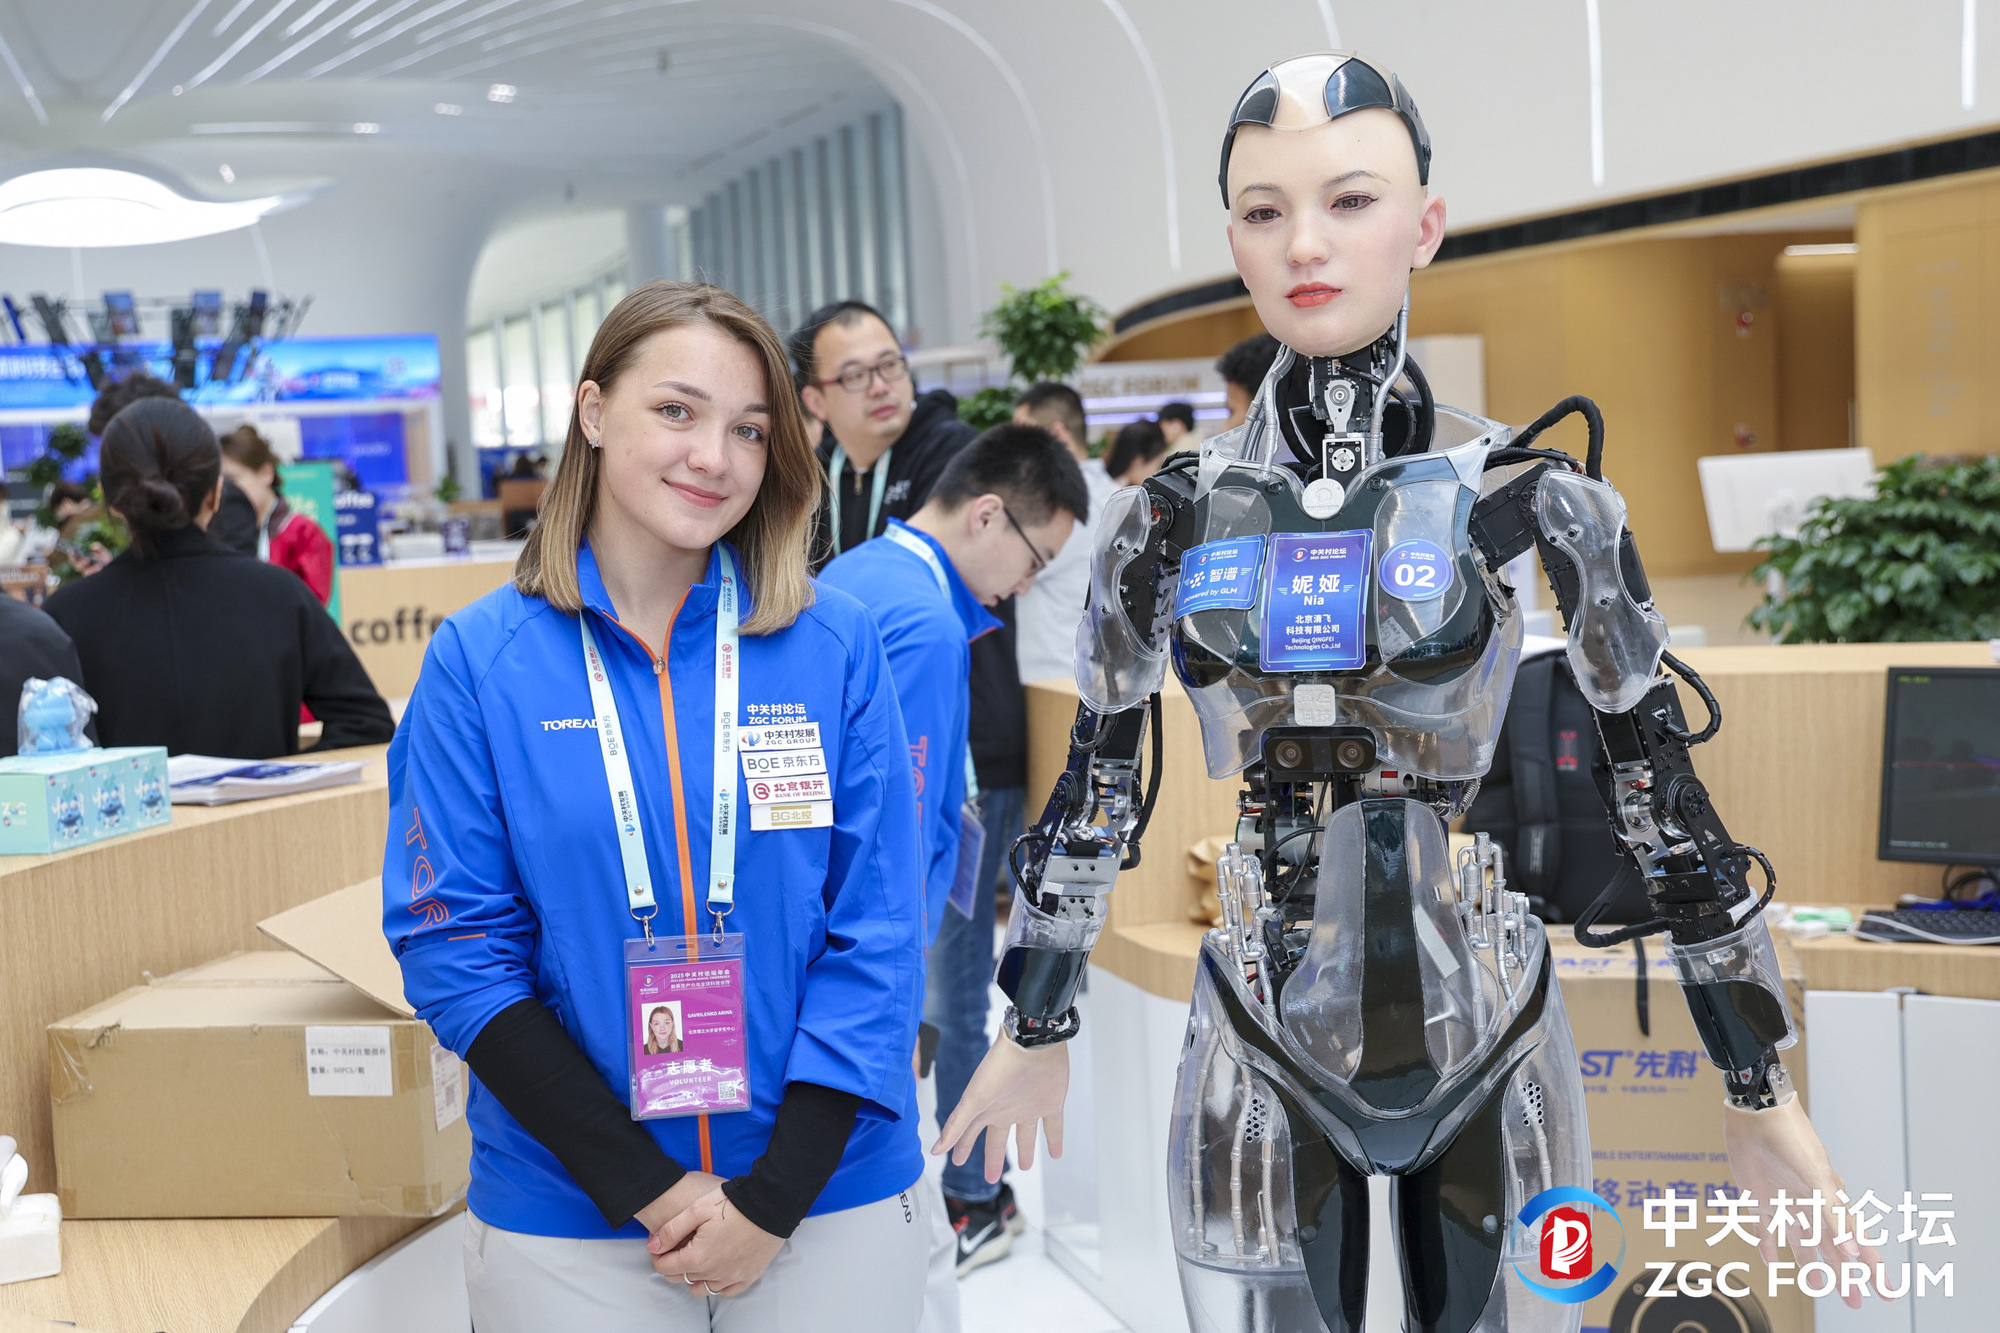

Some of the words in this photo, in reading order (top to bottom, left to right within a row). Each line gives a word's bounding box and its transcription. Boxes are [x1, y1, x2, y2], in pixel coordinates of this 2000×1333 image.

[1310, 548, 1346, 556] 中关村论坛
[1210, 567, 1238, 582] 智谱
[1395, 564, 1436, 588] 02
[1291, 574, 1340, 594] 妮娅
[1184, 590, 1209, 604] powered
[1210, 588, 1219, 596] by
[1304, 595, 1325, 606] Nia
[1295, 614, 1332, 624] 北京清飞
[1286, 624, 1340, 635] 科技有限公司
[1285, 643, 1321, 651] Technologies
[747, 703, 807, 716] 中关村论坛
[748, 716, 770, 725] ZGC
[772, 715, 807, 725] FORUM
[764, 728, 815, 740] 中关村发展
[747, 757, 781, 771] BOE
[782, 754, 820, 768] 京东方
[774, 780, 825, 792] 北京银行
[667, 1058, 713, 1075] 志愿者
[670, 1076, 712, 1086] VOLUNTEER
